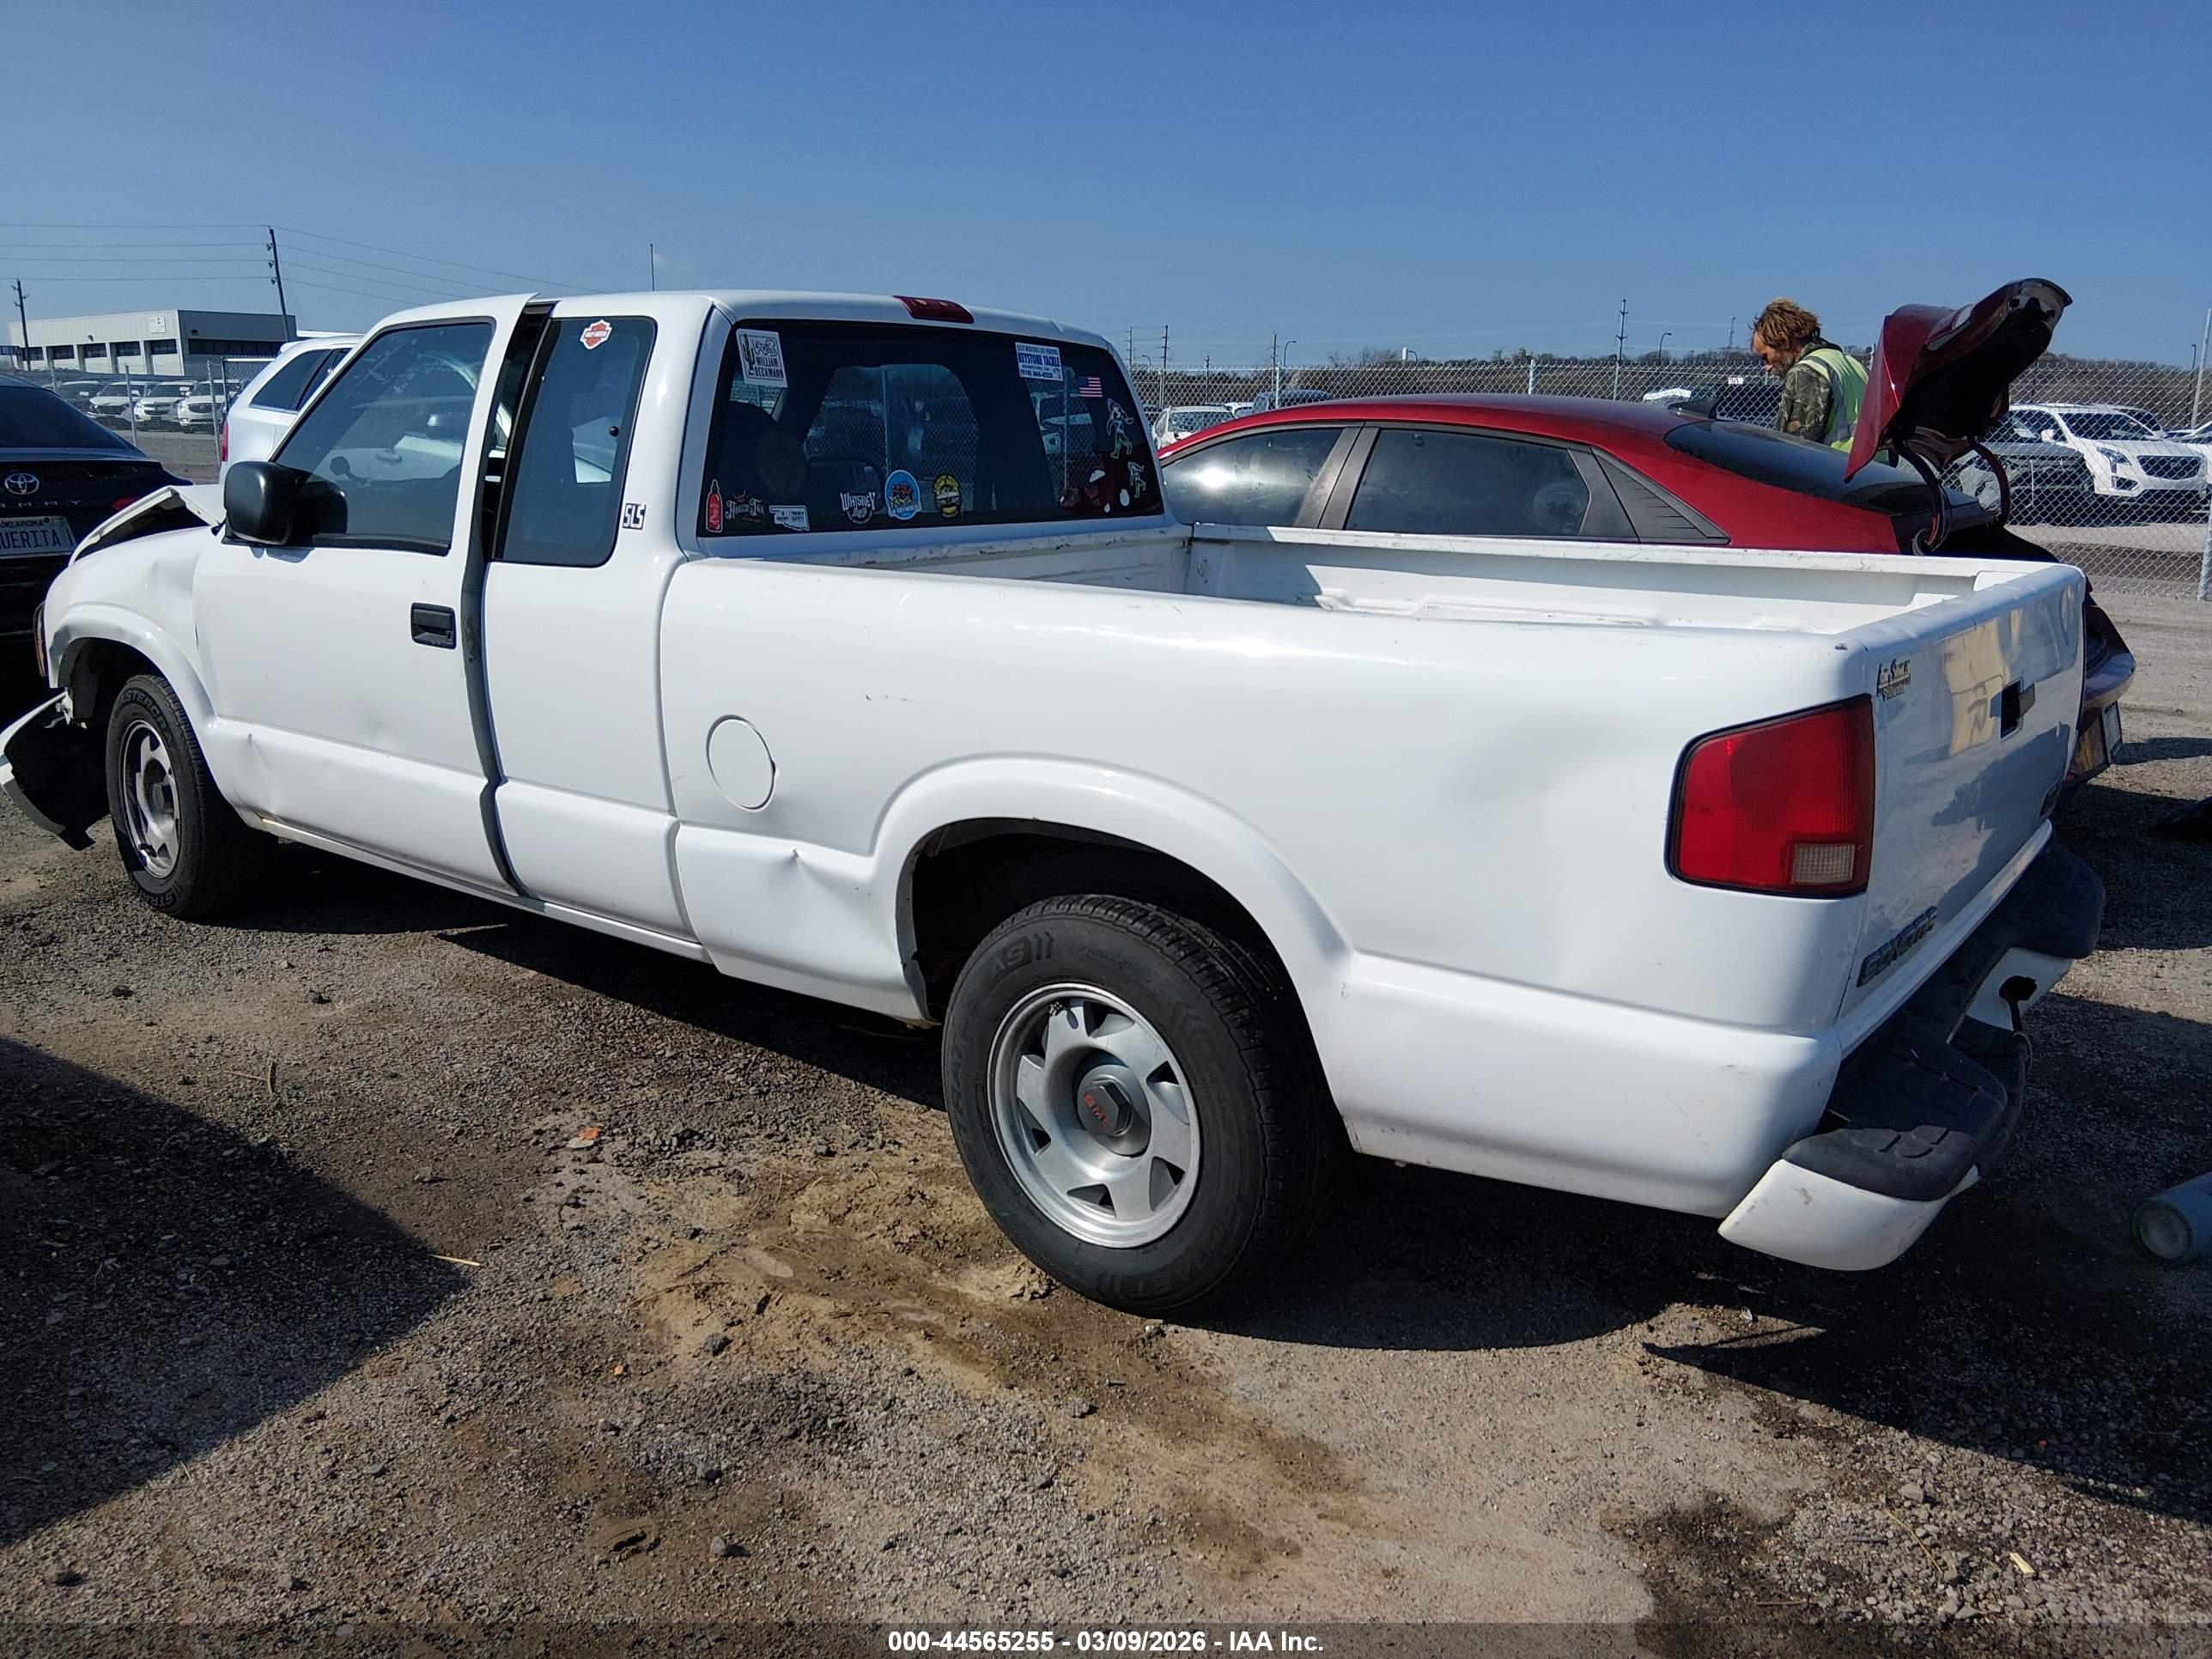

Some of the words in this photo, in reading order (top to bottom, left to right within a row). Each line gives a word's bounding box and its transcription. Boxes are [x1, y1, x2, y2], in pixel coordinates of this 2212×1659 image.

[756, 356, 778, 367] WILLIAM
[1018, 353, 1042, 365] KEYSTONE
[1042, 356, 1060, 367] TACKLE
[840, 492, 876, 512] WHISKEY
[622, 503, 646, 530] SLS
[0, 529, 62, 550] UERITA
